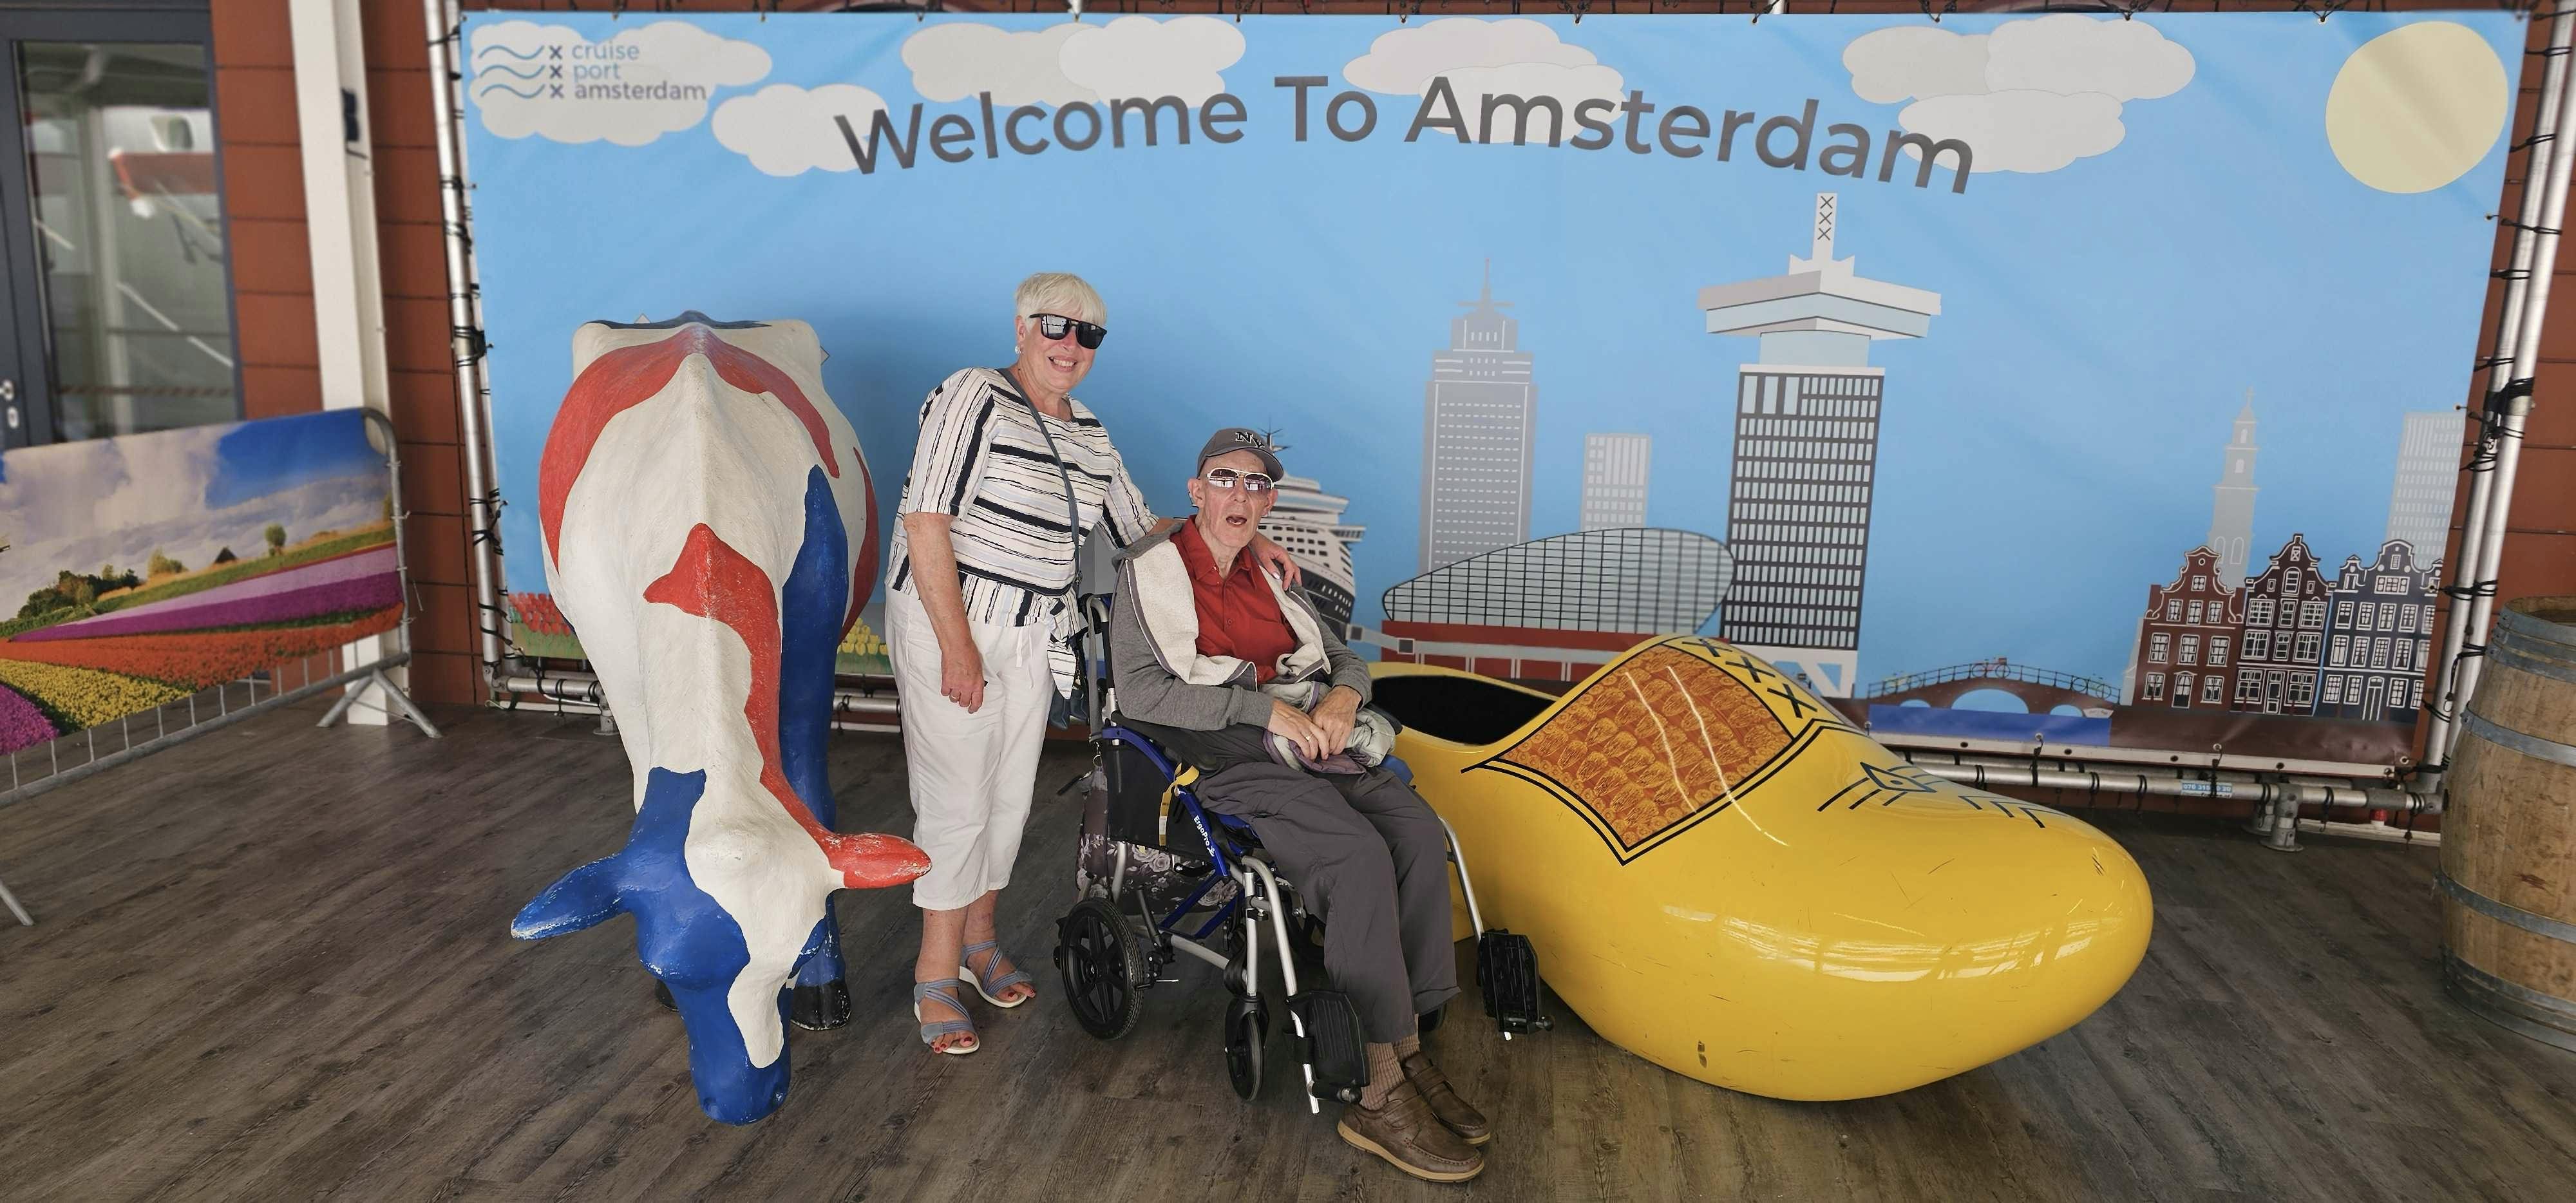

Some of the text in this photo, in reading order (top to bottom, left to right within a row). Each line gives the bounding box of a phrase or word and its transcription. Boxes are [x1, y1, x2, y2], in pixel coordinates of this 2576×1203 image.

[571, 41, 639, 61] cruise
[573, 62, 621, 82] port
[574, 80, 706, 100] amsterdam
[833, 75, 1973, 194] Welcome To Amsterdam
[1235, 431, 1265, 449] NY
[1193, 815, 1210, 846] ErgoPro
